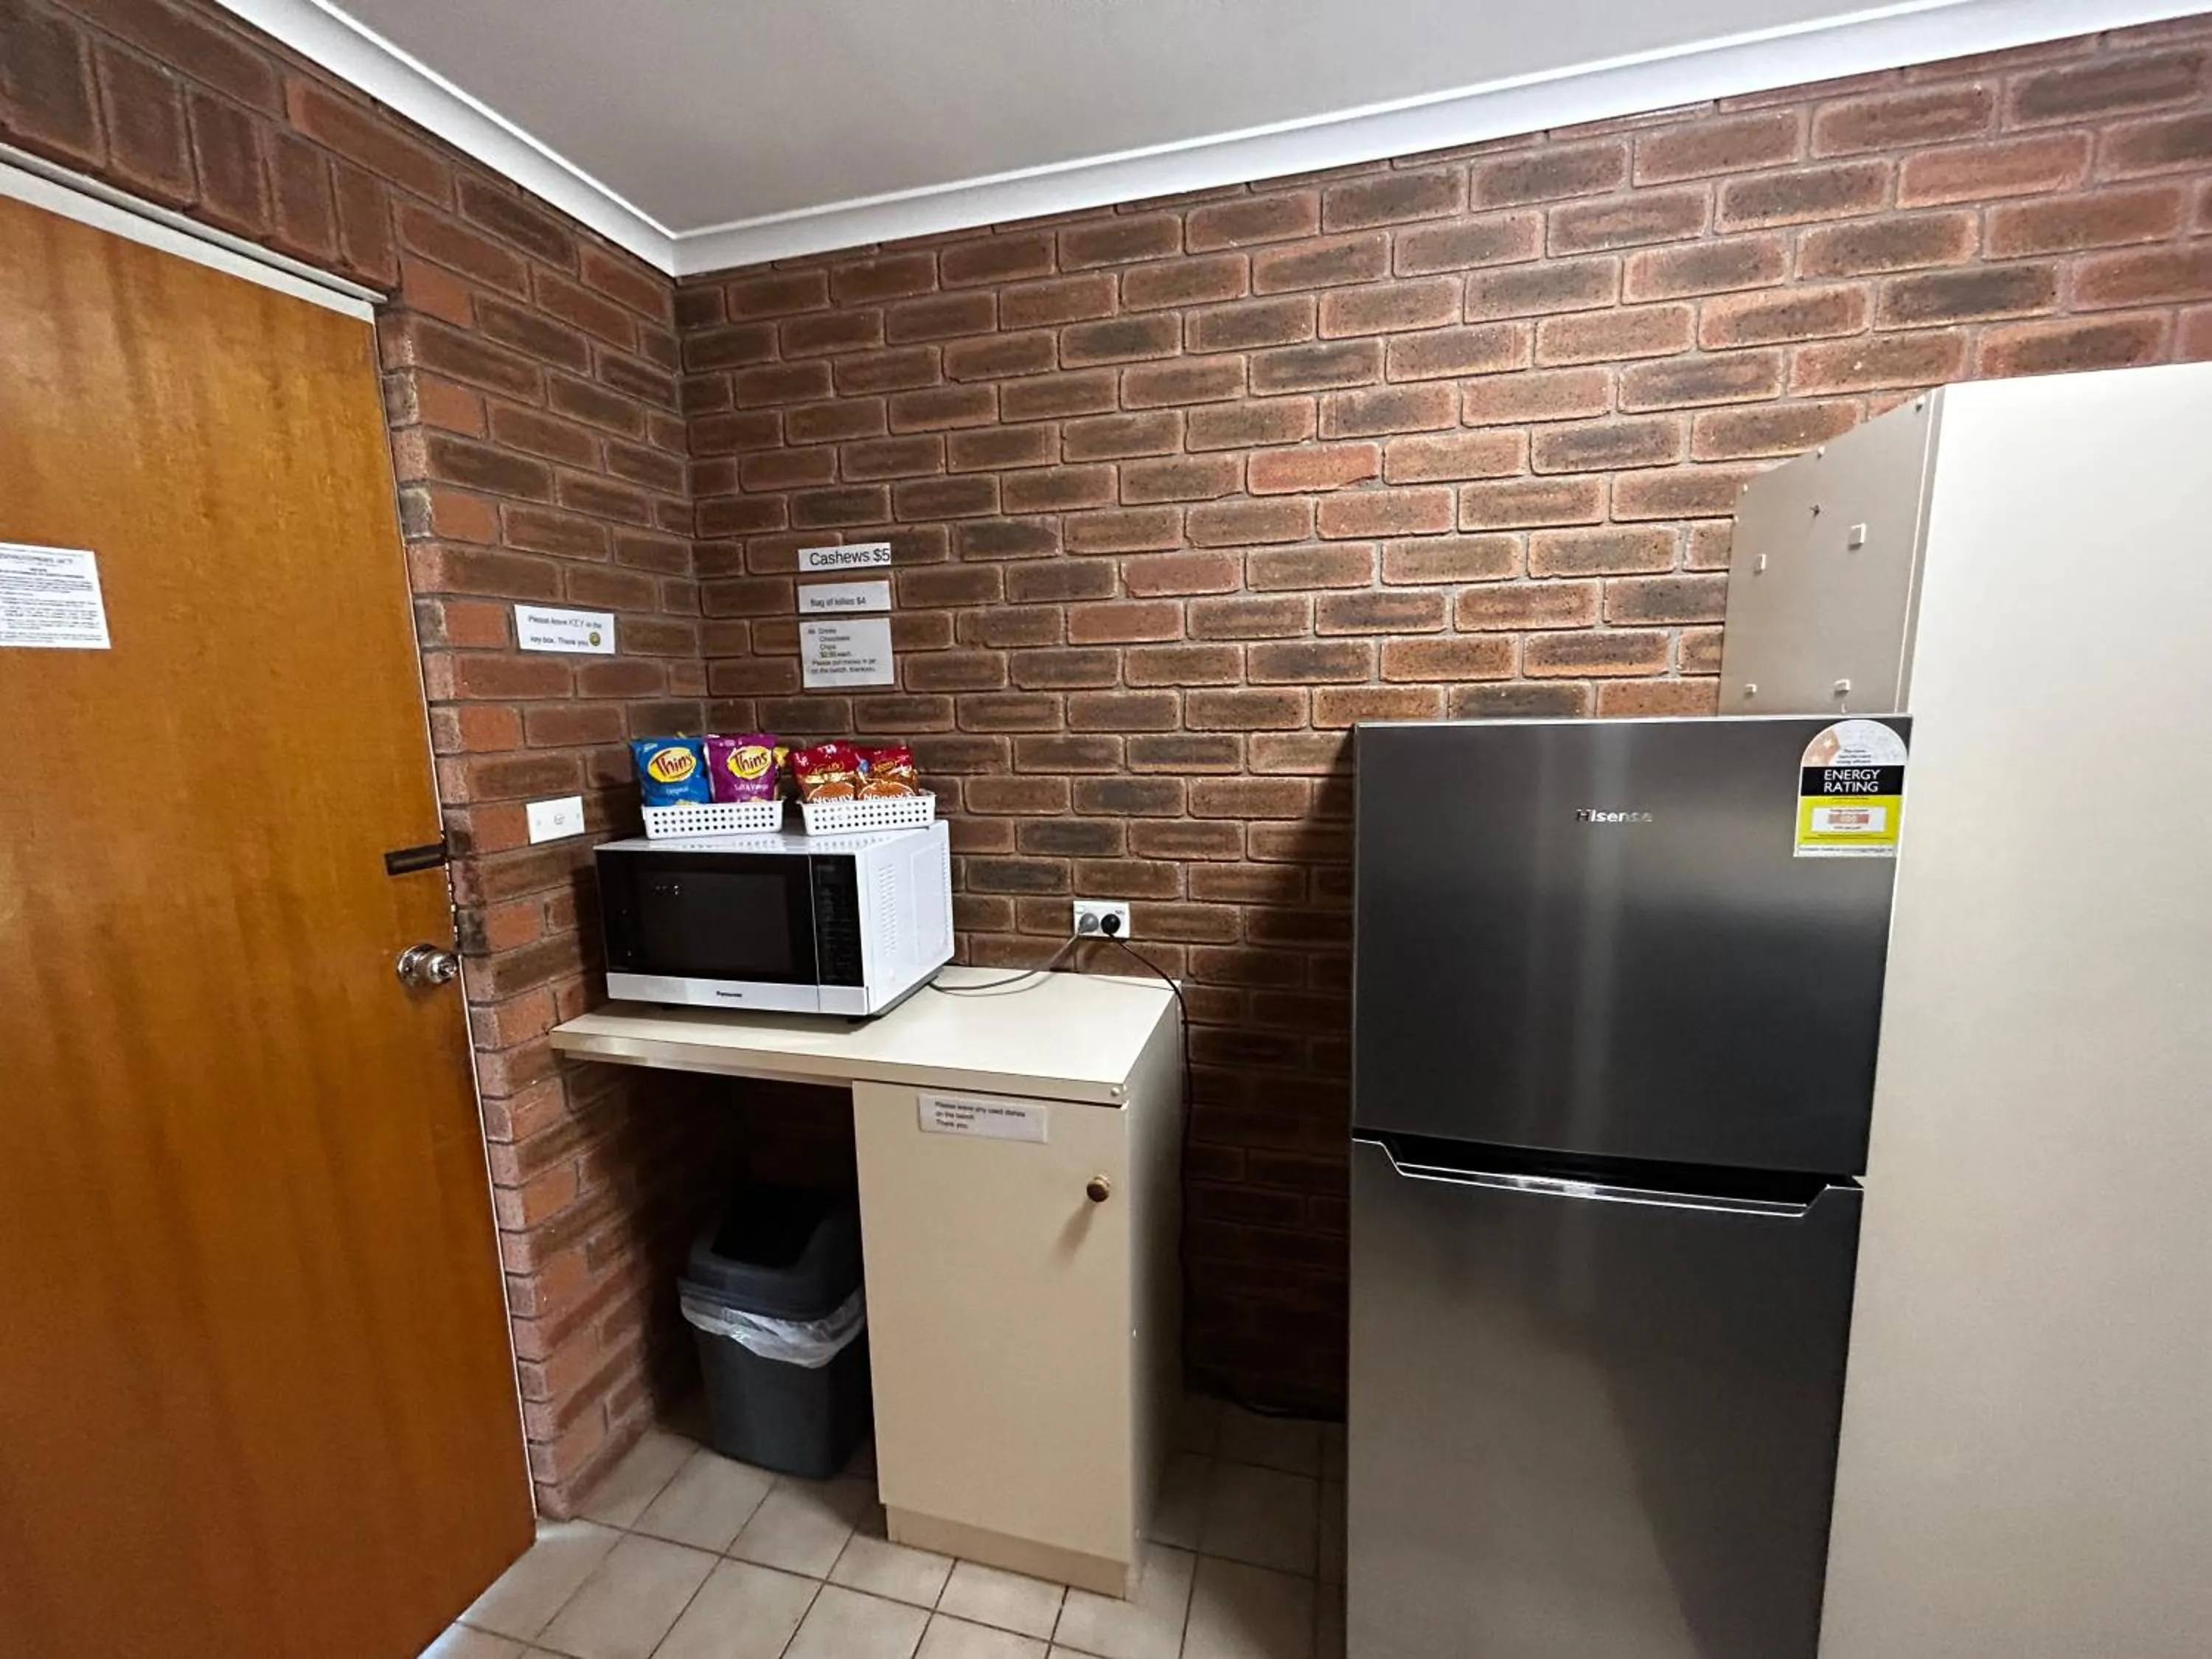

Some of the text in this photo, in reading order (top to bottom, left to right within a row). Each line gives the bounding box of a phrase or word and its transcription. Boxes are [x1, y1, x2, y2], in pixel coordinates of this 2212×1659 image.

[810, 548, 890, 566] Cashews $5
[650, 750, 694, 778] Thins
[730, 751, 767, 773] Thins
[1823, 769, 1880, 781] ENERGY
[1823, 782, 1879, 793] RATING
